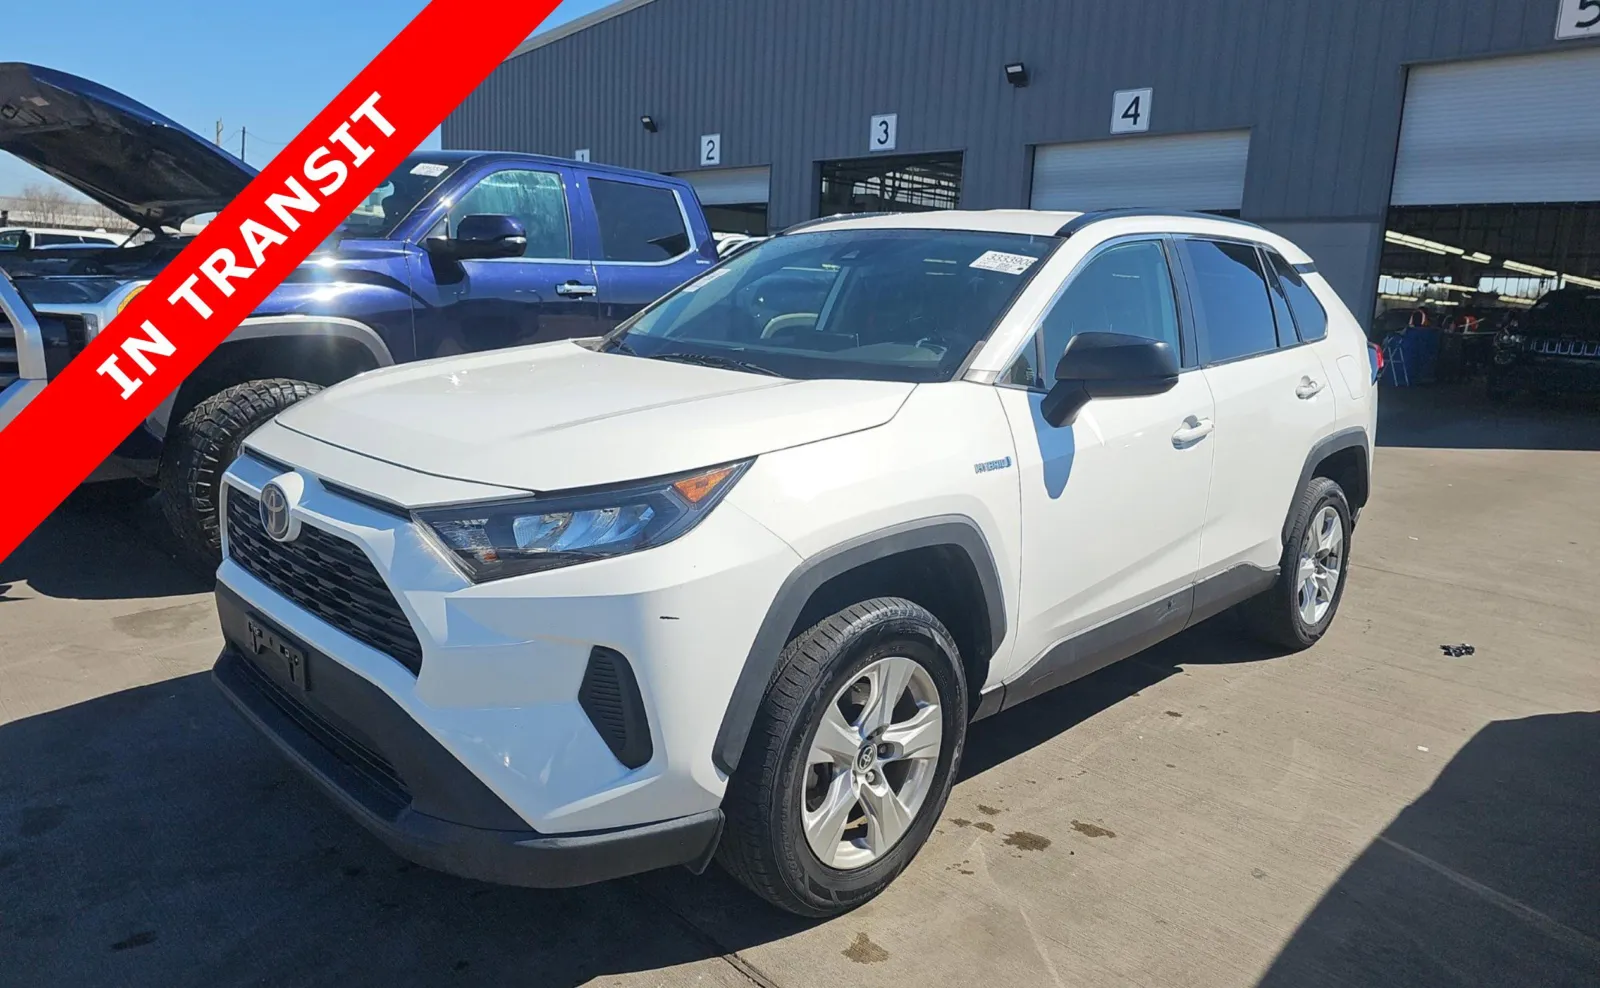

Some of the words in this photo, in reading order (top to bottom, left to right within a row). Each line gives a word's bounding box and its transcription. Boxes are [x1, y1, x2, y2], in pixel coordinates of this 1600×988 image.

[1575, 0, 1600, 28] 5
[1121, 96, 1140, 125] 4
[877, 120, 889, 145] 3
[706, 139, 716, 161] 2
